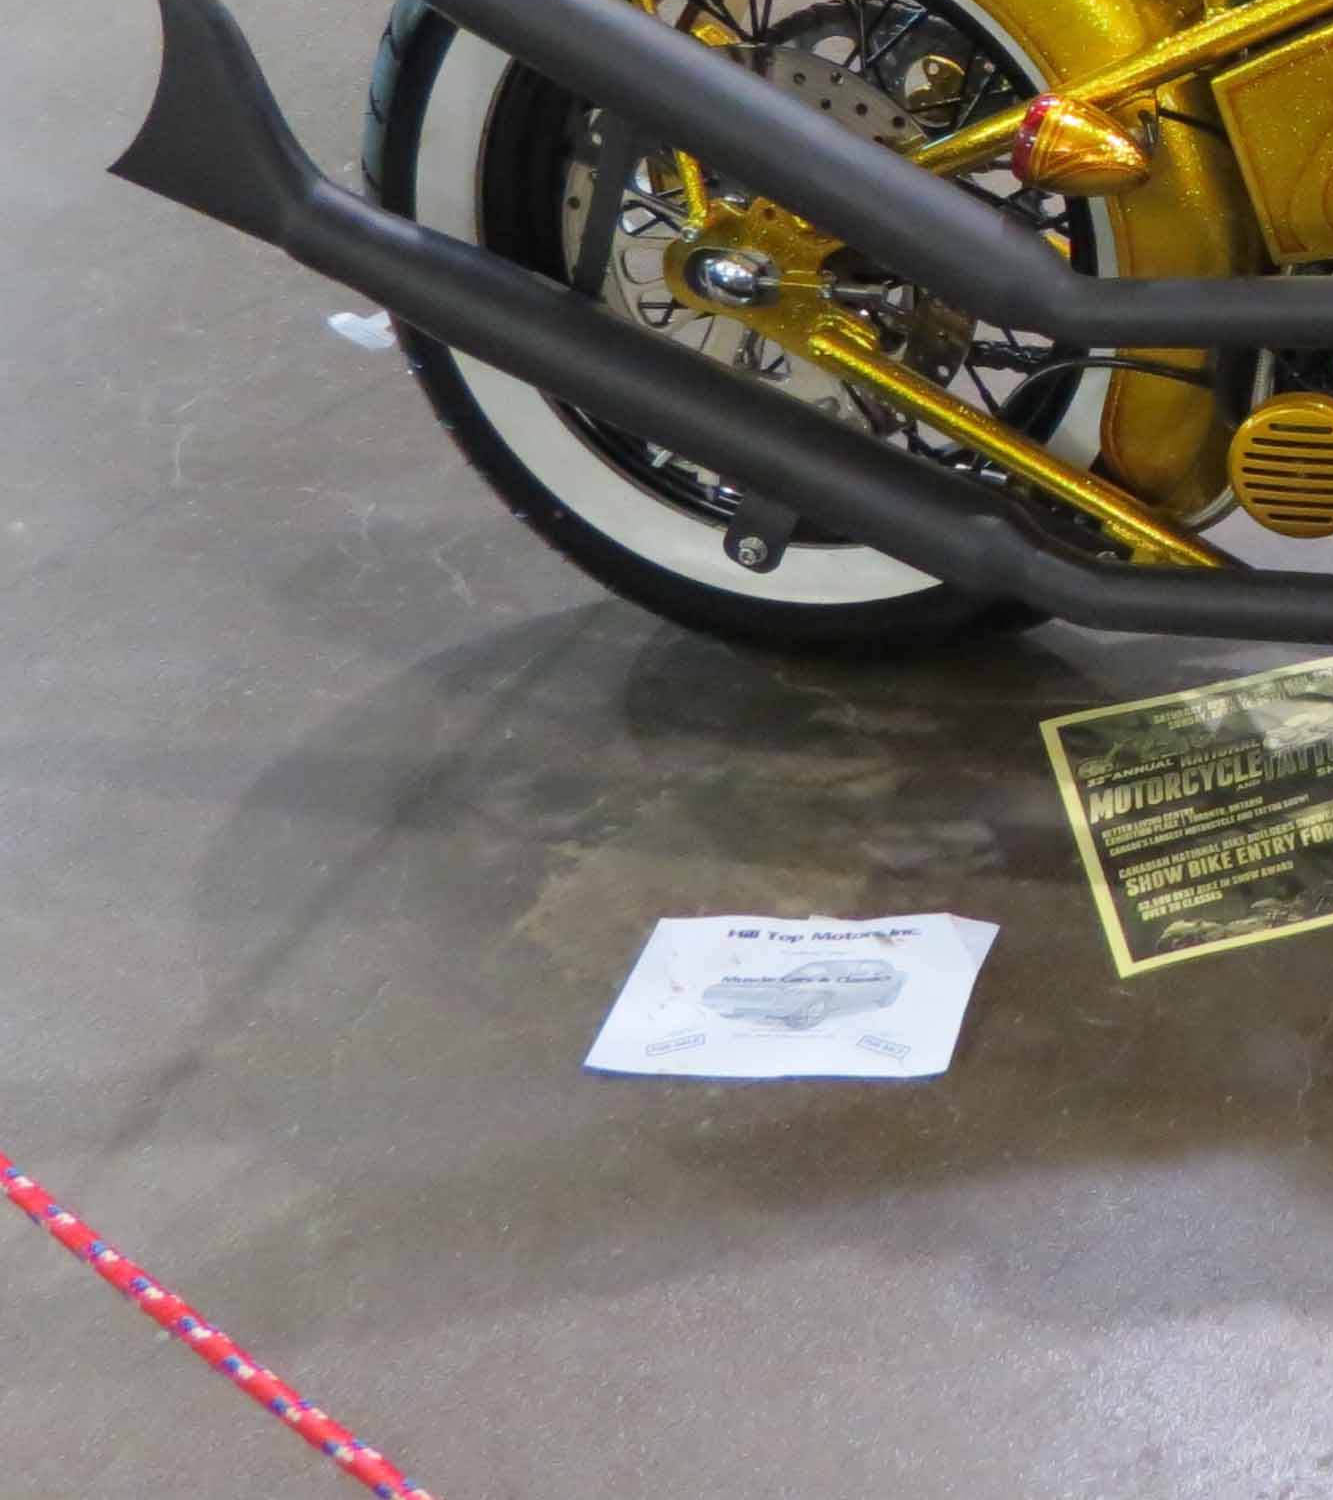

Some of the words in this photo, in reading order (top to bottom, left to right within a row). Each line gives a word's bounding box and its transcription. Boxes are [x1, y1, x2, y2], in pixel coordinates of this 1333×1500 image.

[1089, 749, 1264, 824] MOTORCYCLE
[1125, 866, 1184, 897] SHOW
[1187, 850, 1235, 879] BIKE
[1235, 832, 1297, 866] ENTRY
[727, 928, 761, 940] Hill
[767, 931, 804, 943] Top
